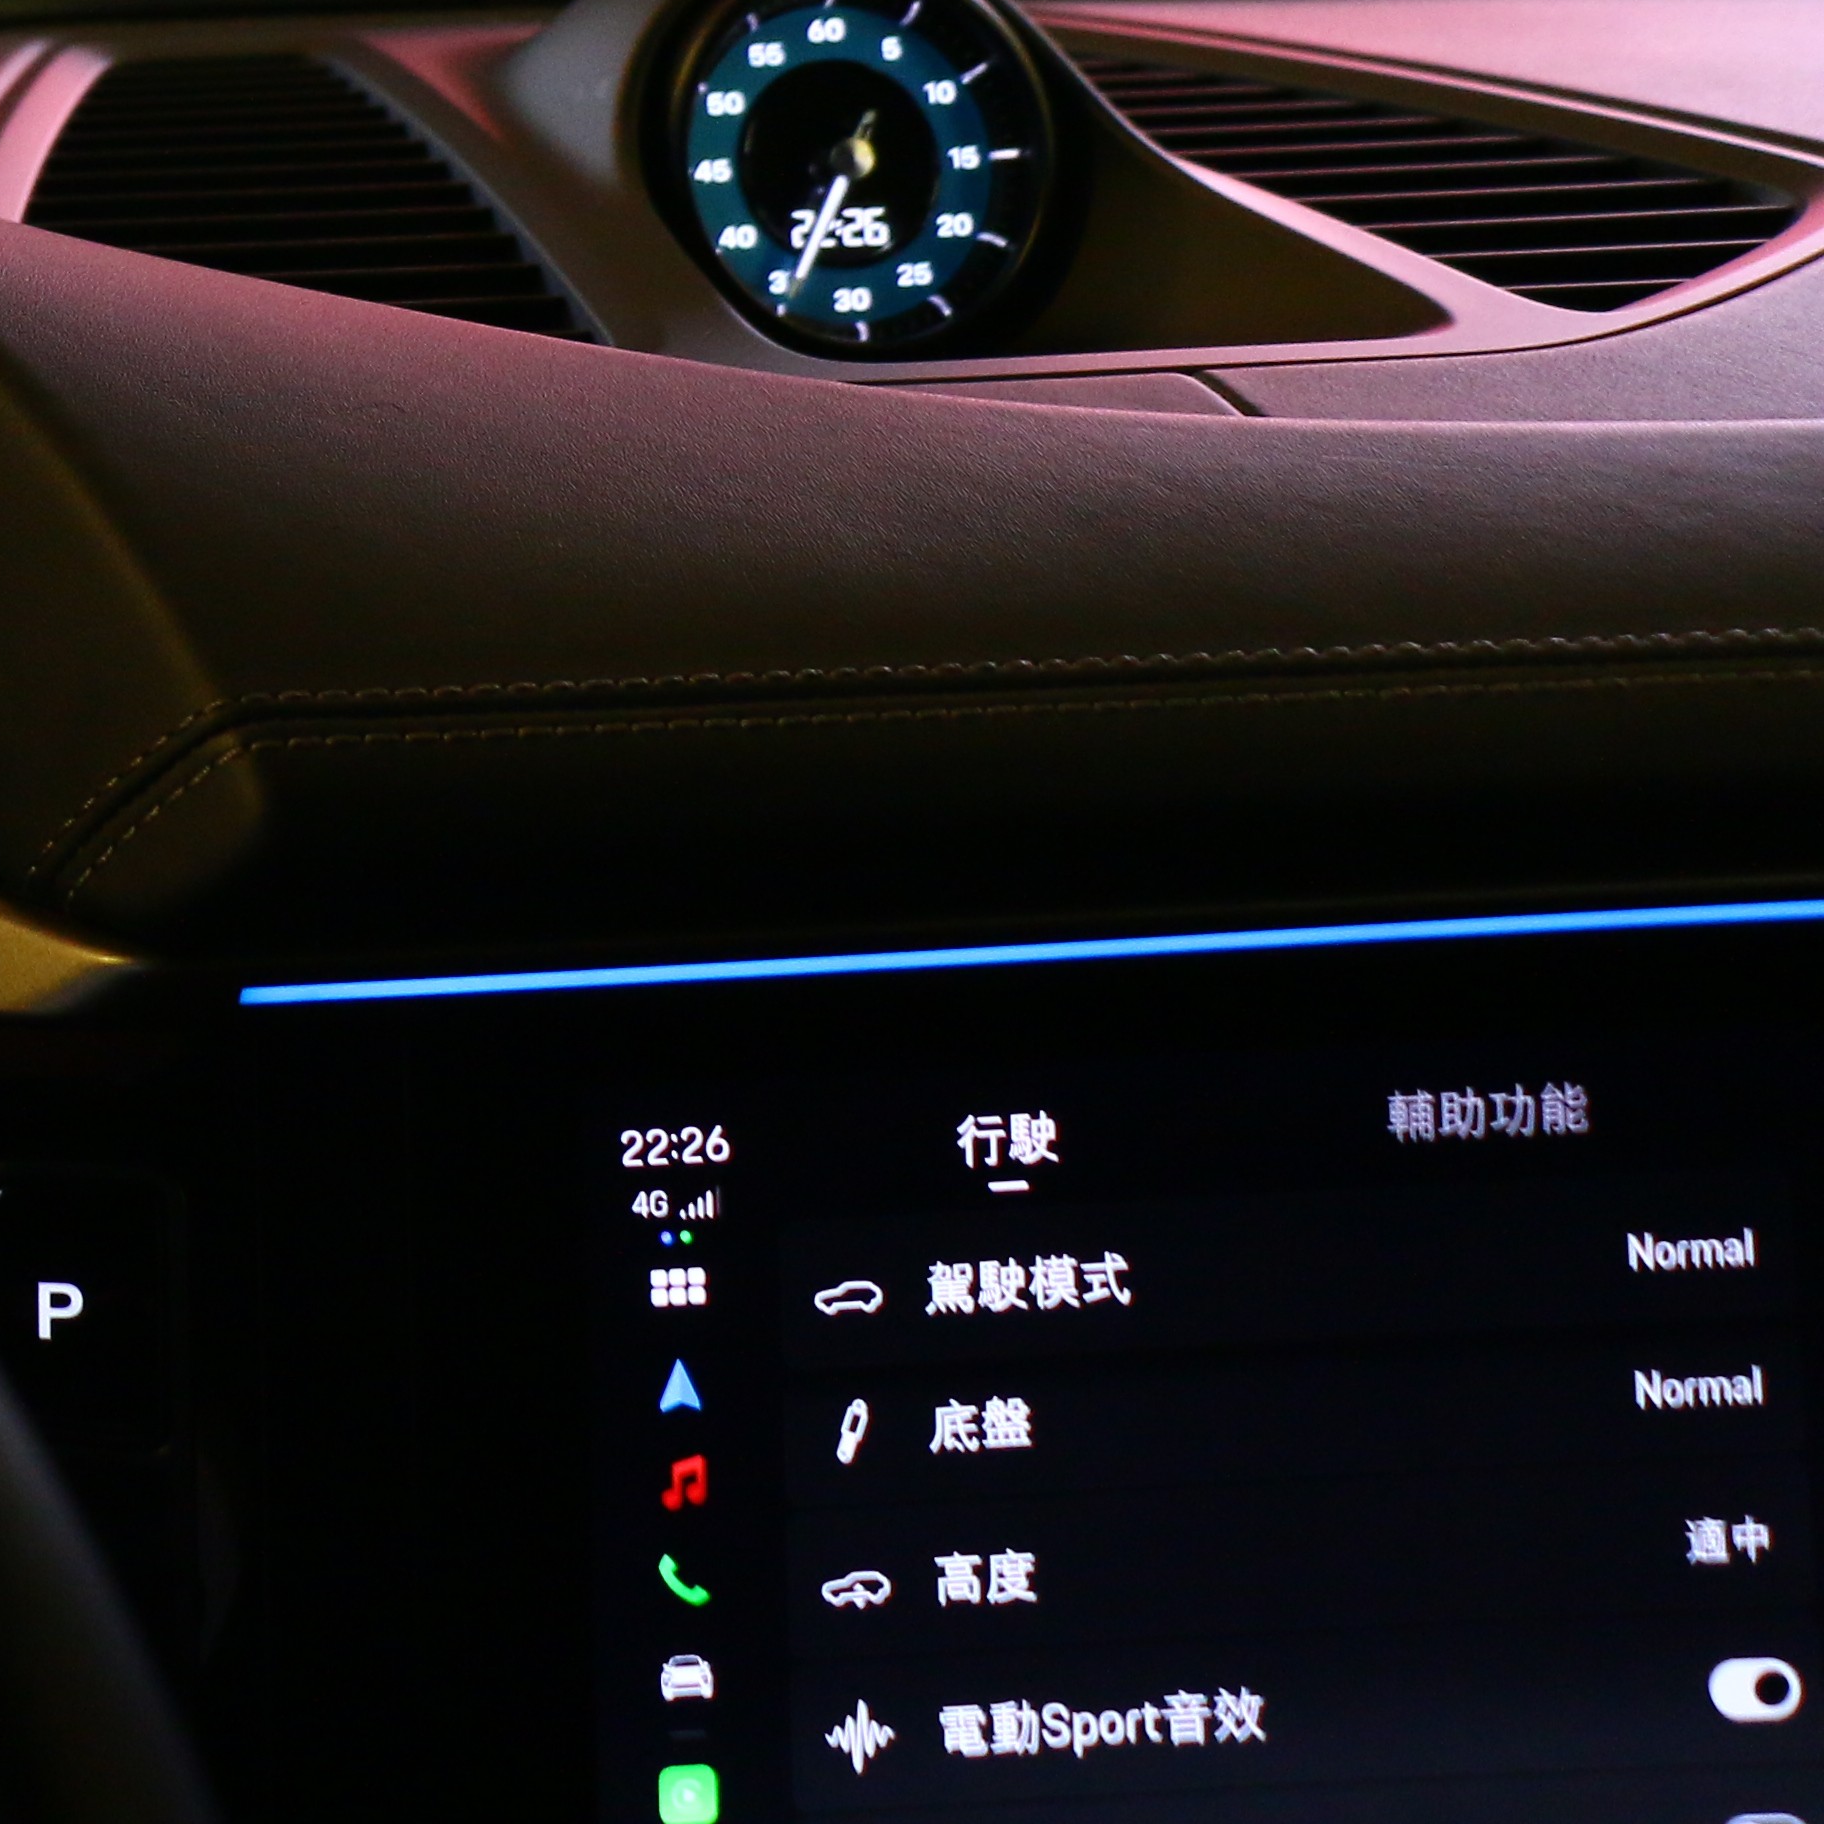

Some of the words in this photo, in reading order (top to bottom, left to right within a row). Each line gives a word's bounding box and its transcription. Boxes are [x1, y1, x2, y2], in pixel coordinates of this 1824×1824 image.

[806, 17, 846, 43] 60
[747, 42, 786, 68] 55
[880, 36, 903, 61] 5
[706, 91, 746, 117] 50
[922, 79, 957, 105] 10
[693, 158, 733, 183] 45
[946, 145, 981, 170] 15
[718, 224, 758, 249] 40
[935, 212, 974, 238] 20
[768, 269, 792, 295] 3
[896, 261, 934, 287] 25
[832, 287, 872, 313] 30
[1386, 1081, 1589, 1143] 輔助功能
[620, 1124, 731, 1168] 22:26
[956, 1109, 1060, 1169] 行駛
[631, 1189, 669, 1219] 4G
[1626, 1227, 1755, 1272] Normal
[924, 1250, 1132, 1316] 駕駛模式
[37, 1281, 84, 1340] P
[1633, 1364, 1764, 1410] Normal
[928, 1395, 1033, 1454] 底盤
[1684, 1514, 1770, 1565] 適中
[933, 1547, 1038, 1607] 高度
[938, 1685, 1267, 1759] 電動Sport音效
